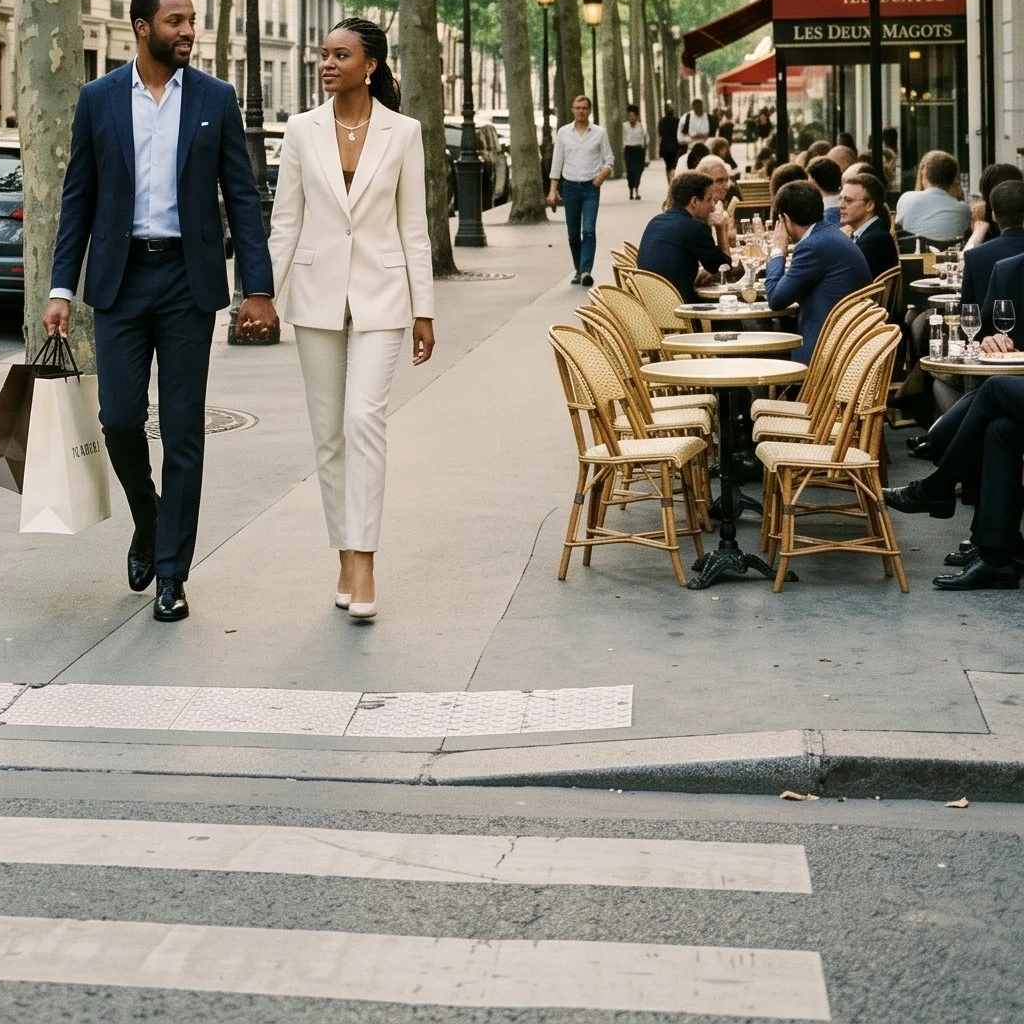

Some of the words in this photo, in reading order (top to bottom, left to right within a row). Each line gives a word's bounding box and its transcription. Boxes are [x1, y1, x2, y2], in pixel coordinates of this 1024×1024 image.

[793, 25, 823, 41] LES
[827, 24, 872, 40] DEUX
[882, 24, 953, 39] MAGOTS
